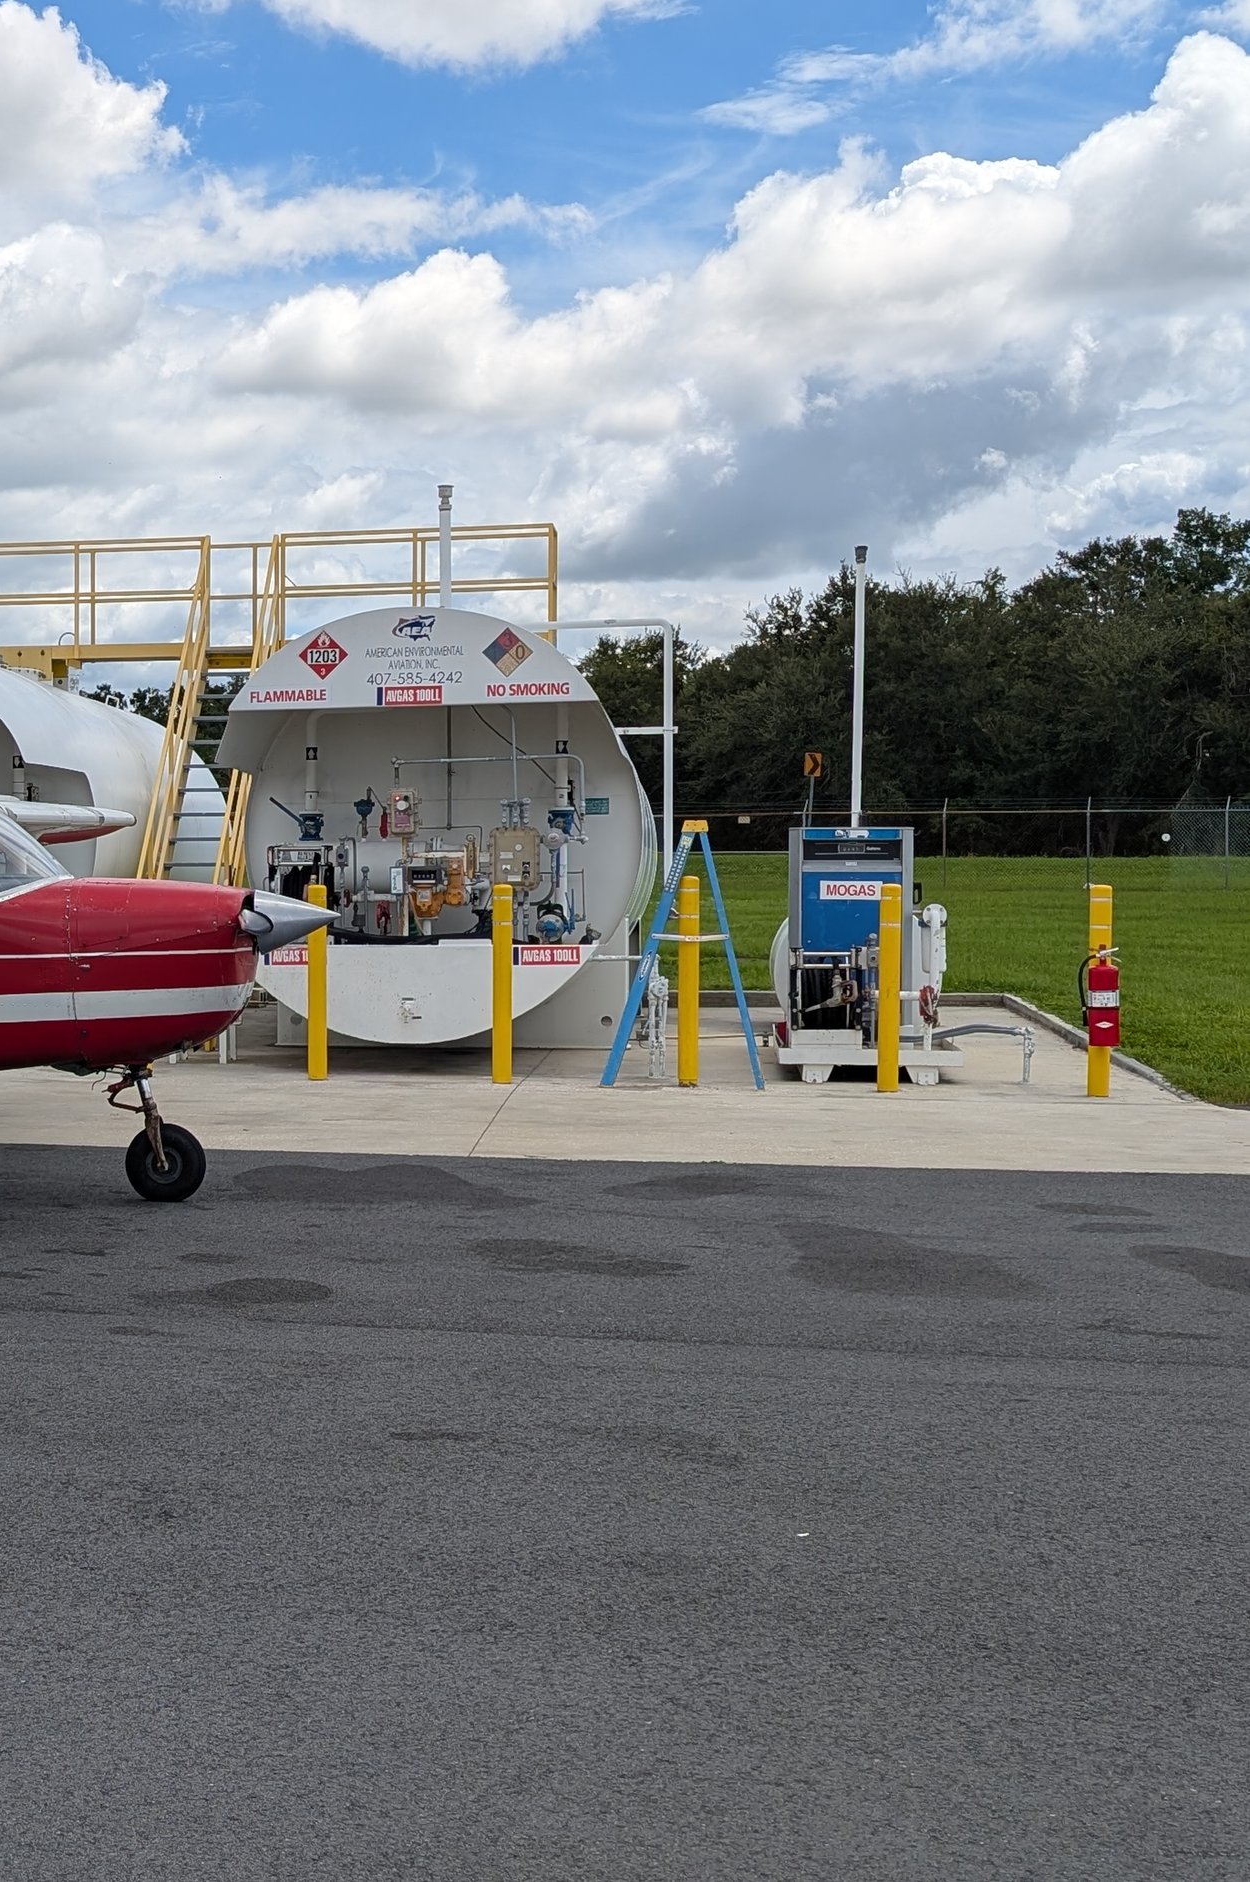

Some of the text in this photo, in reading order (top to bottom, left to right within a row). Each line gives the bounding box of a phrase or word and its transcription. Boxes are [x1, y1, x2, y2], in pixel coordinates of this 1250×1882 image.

[402, 626, 431, 635] AEA
[309, 650, 337, 663] 1203
[365, 645, 464, 658] AMERICAN ENVIRONMENTAL
[516, 645, 525, 660] 0
[425, 658, 440, 669] INC.
[320, 668, 325, 676] 3
[366, 671, 463, 686] 407-585-4242
[250, 689, 327, 703] FLAMMABLE
[386, 688, 441, 702] AVGAS 100LL
[487, 682, 570, 697] NO SMOKING
[826, 884, 876, 896] MOGAS
[273, 951, 301, 963] AVGAS
[522, 949, 579, 962] AVGAS 100LL
